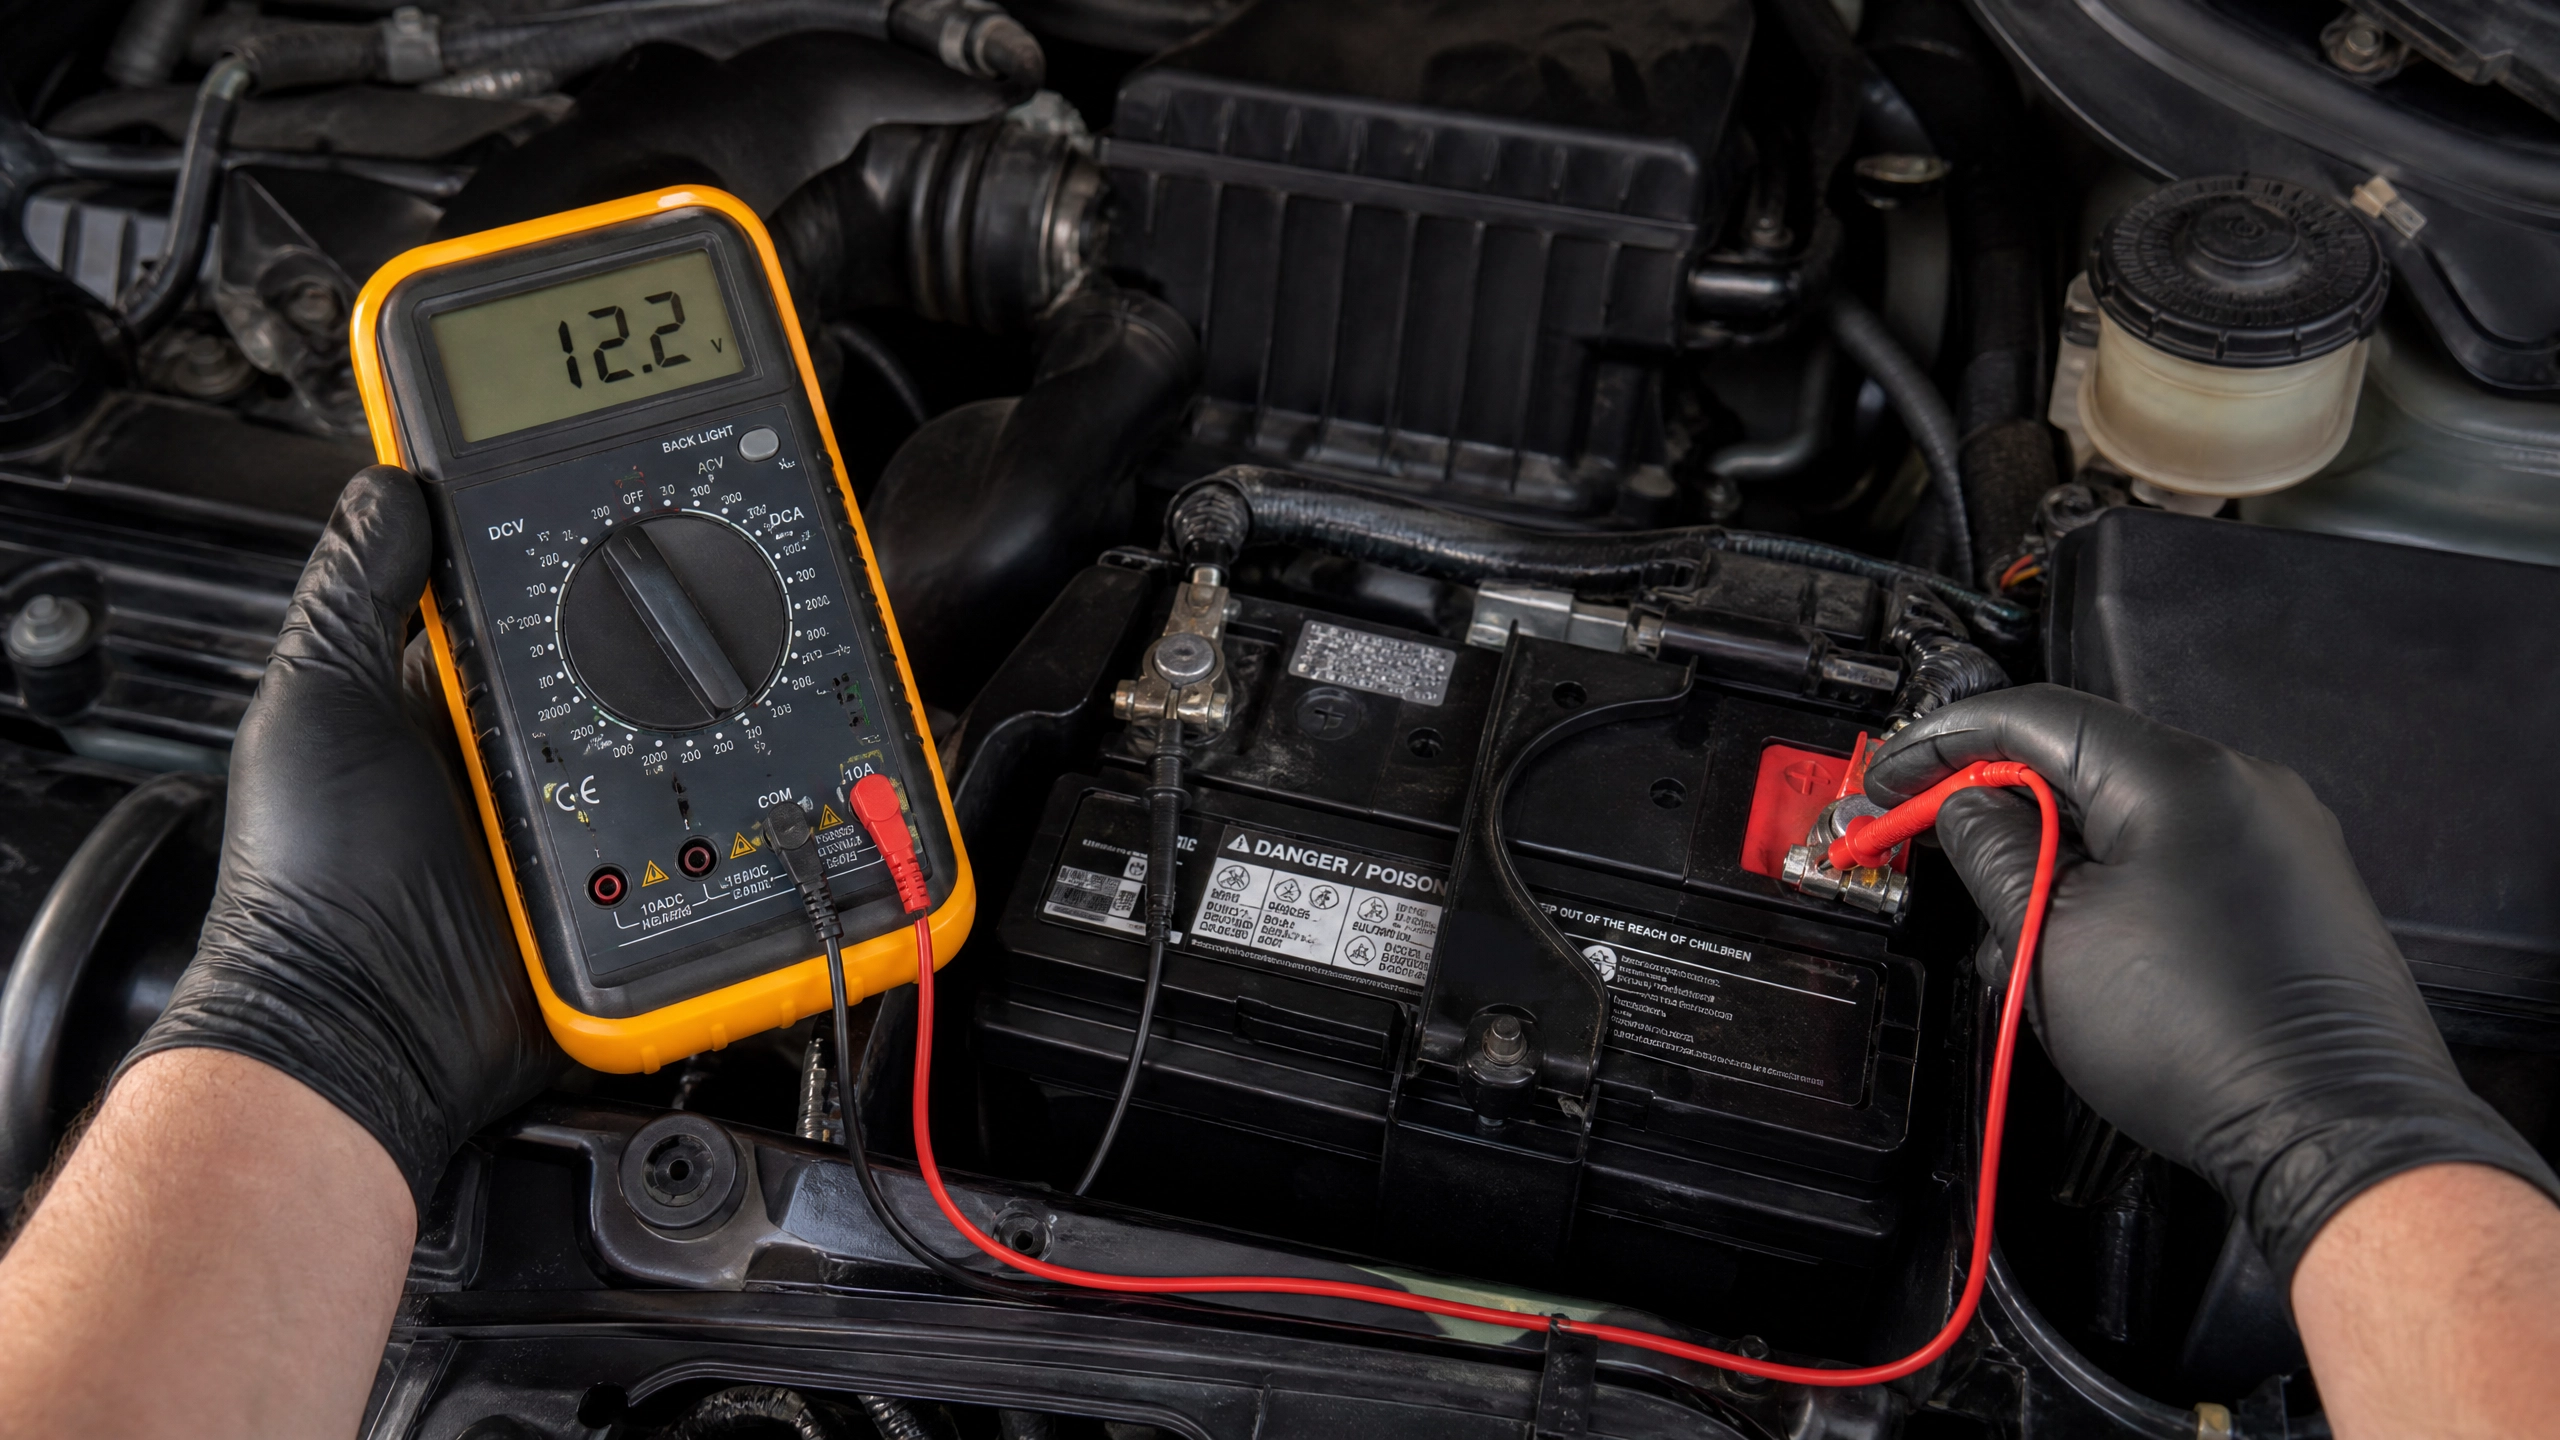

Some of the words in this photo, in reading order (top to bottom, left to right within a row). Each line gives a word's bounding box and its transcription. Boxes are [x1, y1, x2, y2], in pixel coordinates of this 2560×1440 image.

[558, 290, 692, 389] 12.2
[662, 435, 697, 454] BACK
[699, 425, 734, 444] LIGHT
[698, 456, 724, 474] ACV
[622, 490, 644, 505] OFF
[769, 506, 805, 527] DCA
[488, 518, 524, 541] DCV
[796, 567, 816, 582] 200
[526, 582, 547, 597] 200
[516, 613, 541, 630] 2000
[529, 644, 544, 658] 20
[680, 749, 701, 764] 200
[713, 740, 734, 755] 200
[641, 750, 668, 766] 2000
[844, 762, 875, 782] 10A
[555, 775, 600, 812] CE
[758, 787, 793, 808] COM
[1254, 839, 1349, 874] DANGER
[1365, 863, 1448, 897] POISON
[640, 893, 685, 916] 10ADC
[1560, 907, 1583, 920] OUT
[1585, 914, 1601, 924] OF
[1602, 917, 1625, 931] THE
[1627, 923, 1668, 941] REACH
[1670, 934, 1687, 945] OF
